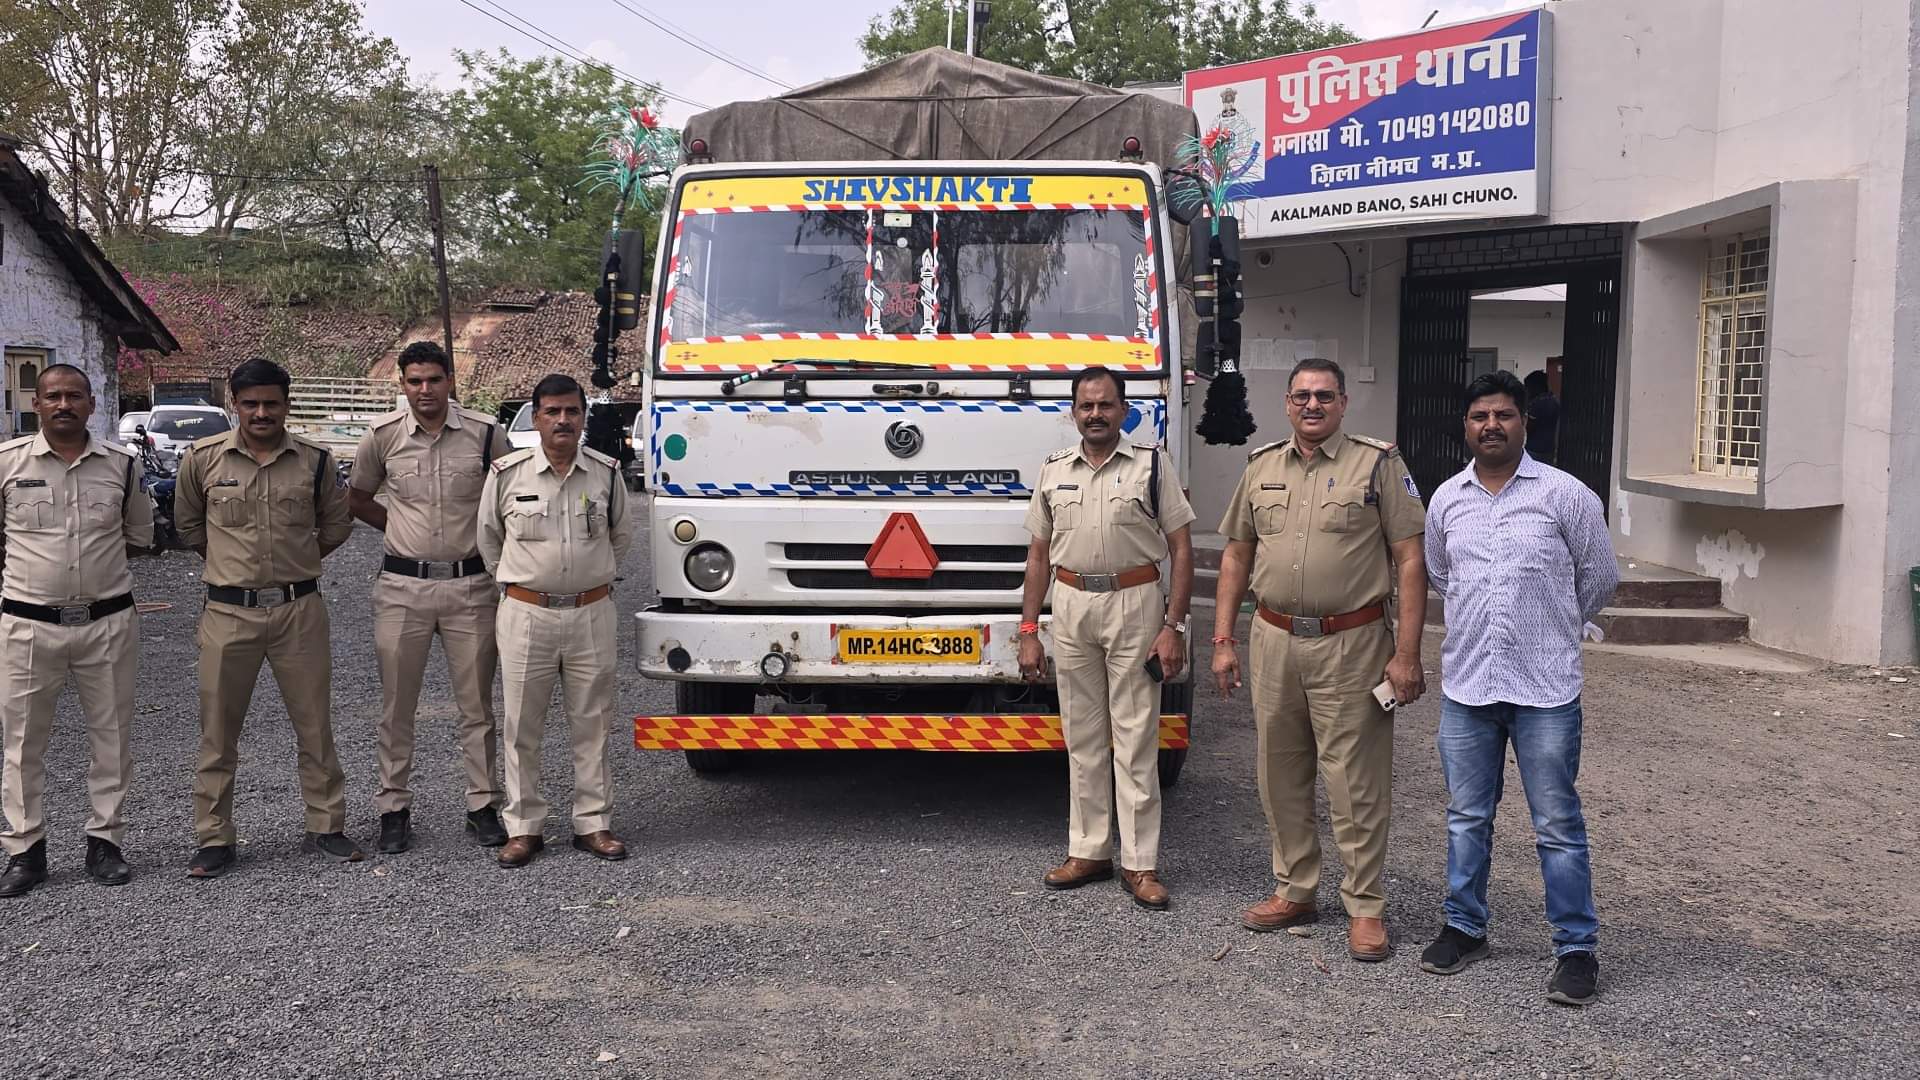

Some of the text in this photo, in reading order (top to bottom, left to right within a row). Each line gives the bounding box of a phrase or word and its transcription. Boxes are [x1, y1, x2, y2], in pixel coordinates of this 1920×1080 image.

[1278, 34, 1527, 124] पुलिस थाना
[1272, 101, 1530, 156] मनासा मो. 7049142080
[1366, 156, 1420, 178] नीमच
[1431, 150, 1481, 172] म.प्र.
[802, 177, 1033, 203] SHIVSHAKTI
[1270, 187, 1518, 222] AKALMAND BANO, SAHI CHUNO.
[899, 471, 1015, 484] LEYLAND
